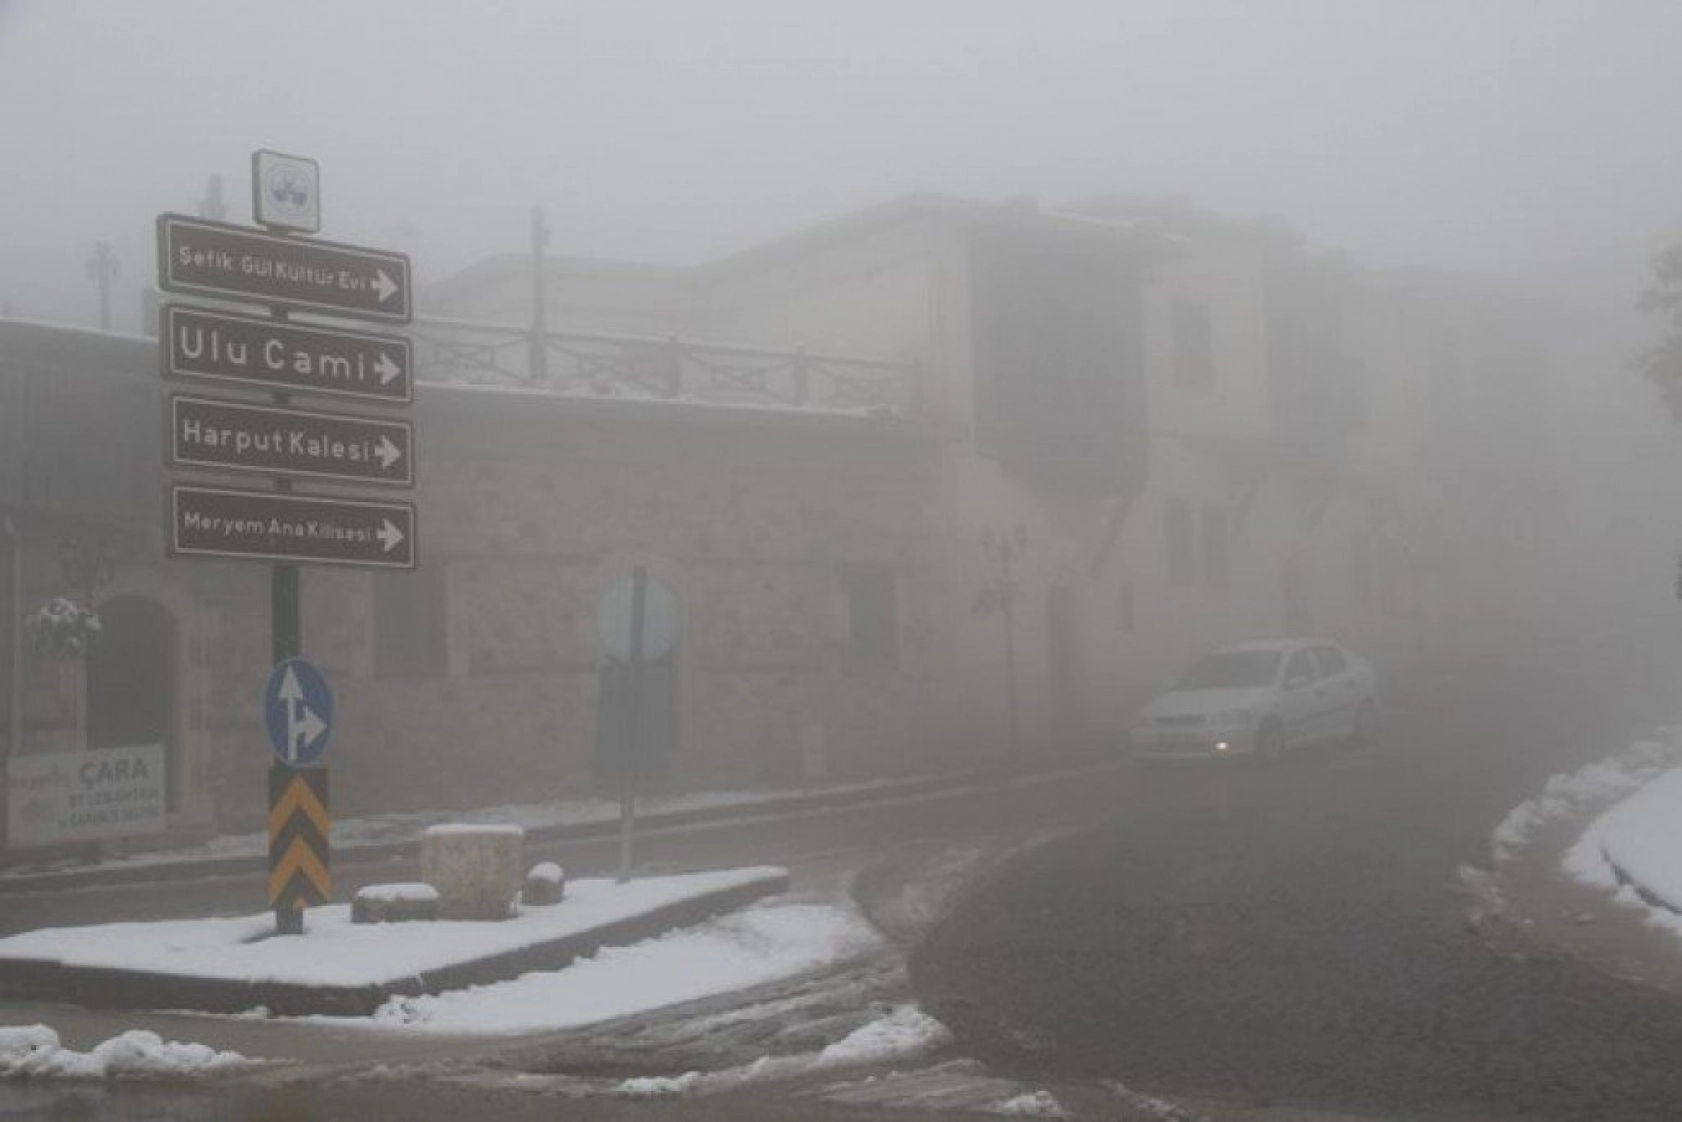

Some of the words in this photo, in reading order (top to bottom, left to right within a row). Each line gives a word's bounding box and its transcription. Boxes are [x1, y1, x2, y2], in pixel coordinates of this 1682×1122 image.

[180, 326, 247, 364] Ulu
[265, 338, 364, 381] Cami
[183, 418, 283, 454] Harput
[290, 431, 370, 462] Kalesi
[184, 511, 263, 535] Meryem
[268, 517, 304, 537] Ana
